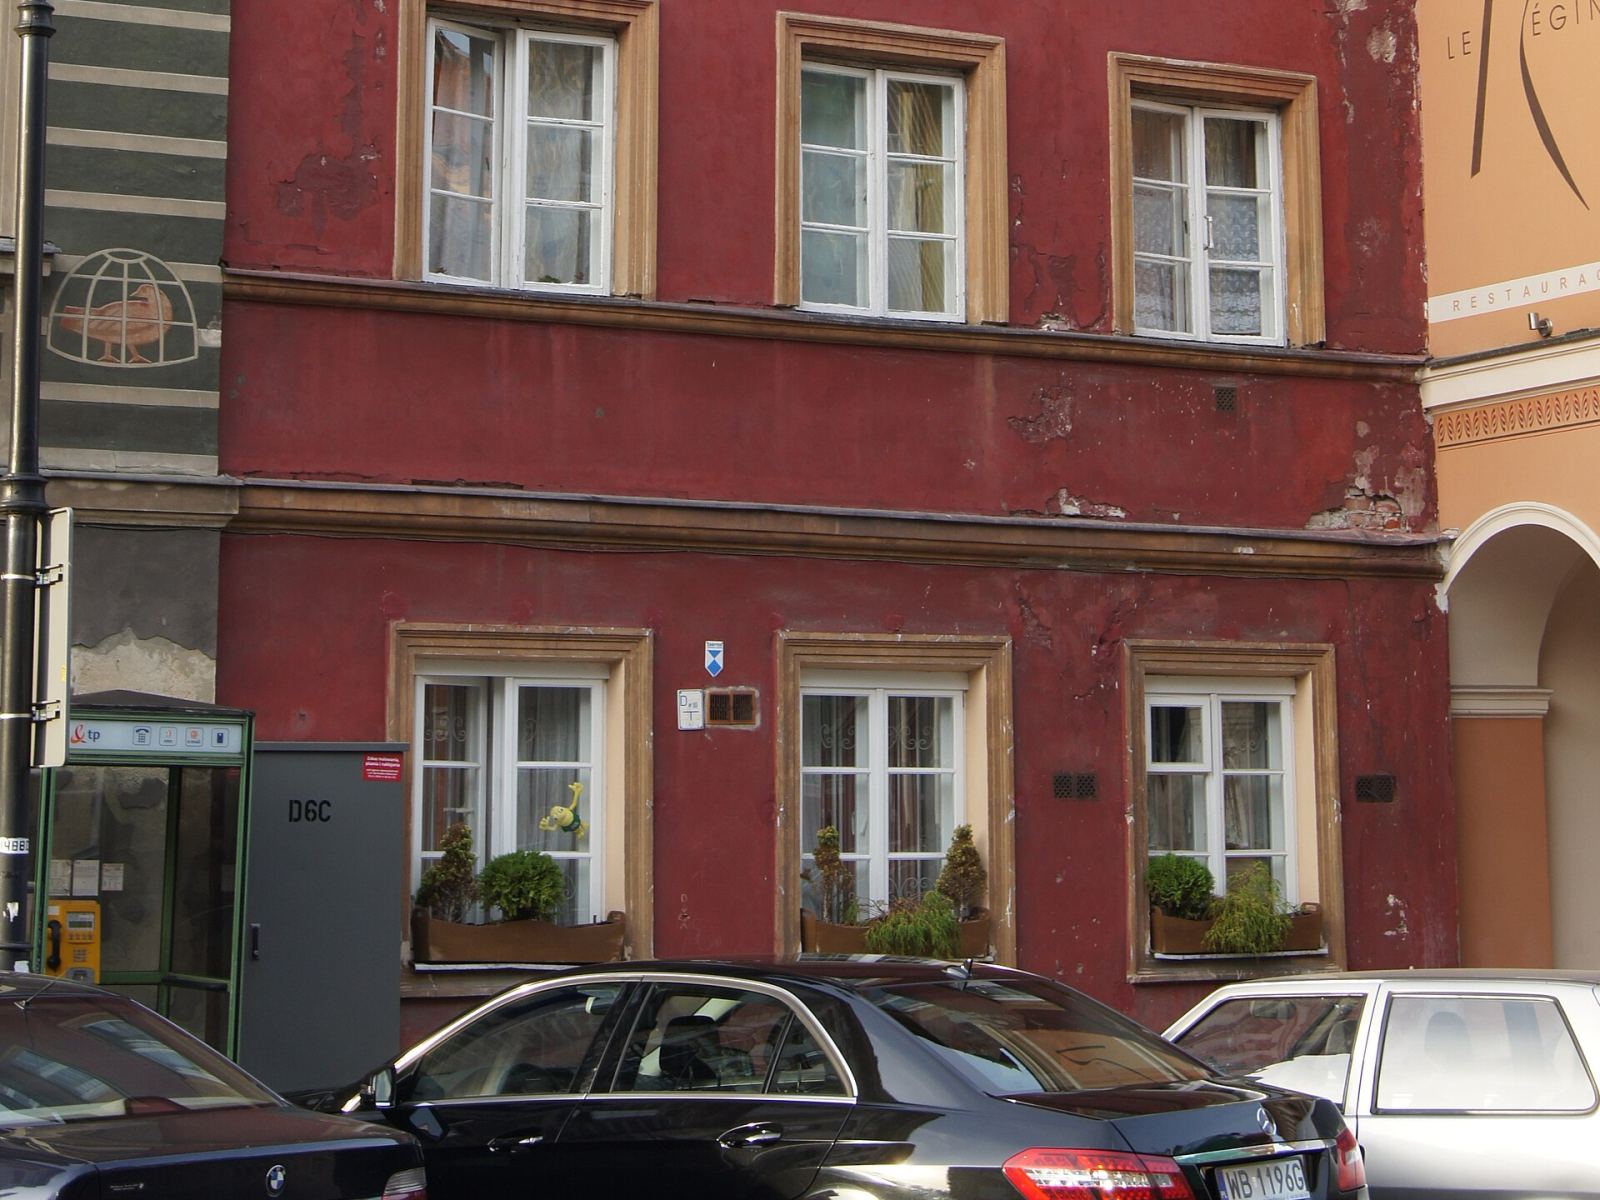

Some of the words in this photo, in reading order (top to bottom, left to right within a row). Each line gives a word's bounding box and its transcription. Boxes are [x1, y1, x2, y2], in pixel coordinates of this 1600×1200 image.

[1447, 30, 1472, 60] LE
[88, 729, 101, 742] tp
[288, 799, 331, 823] D6C
[1225, 1169, 1253, 1199] WB
[1256, 1162, 1305, 1196] 1196G
